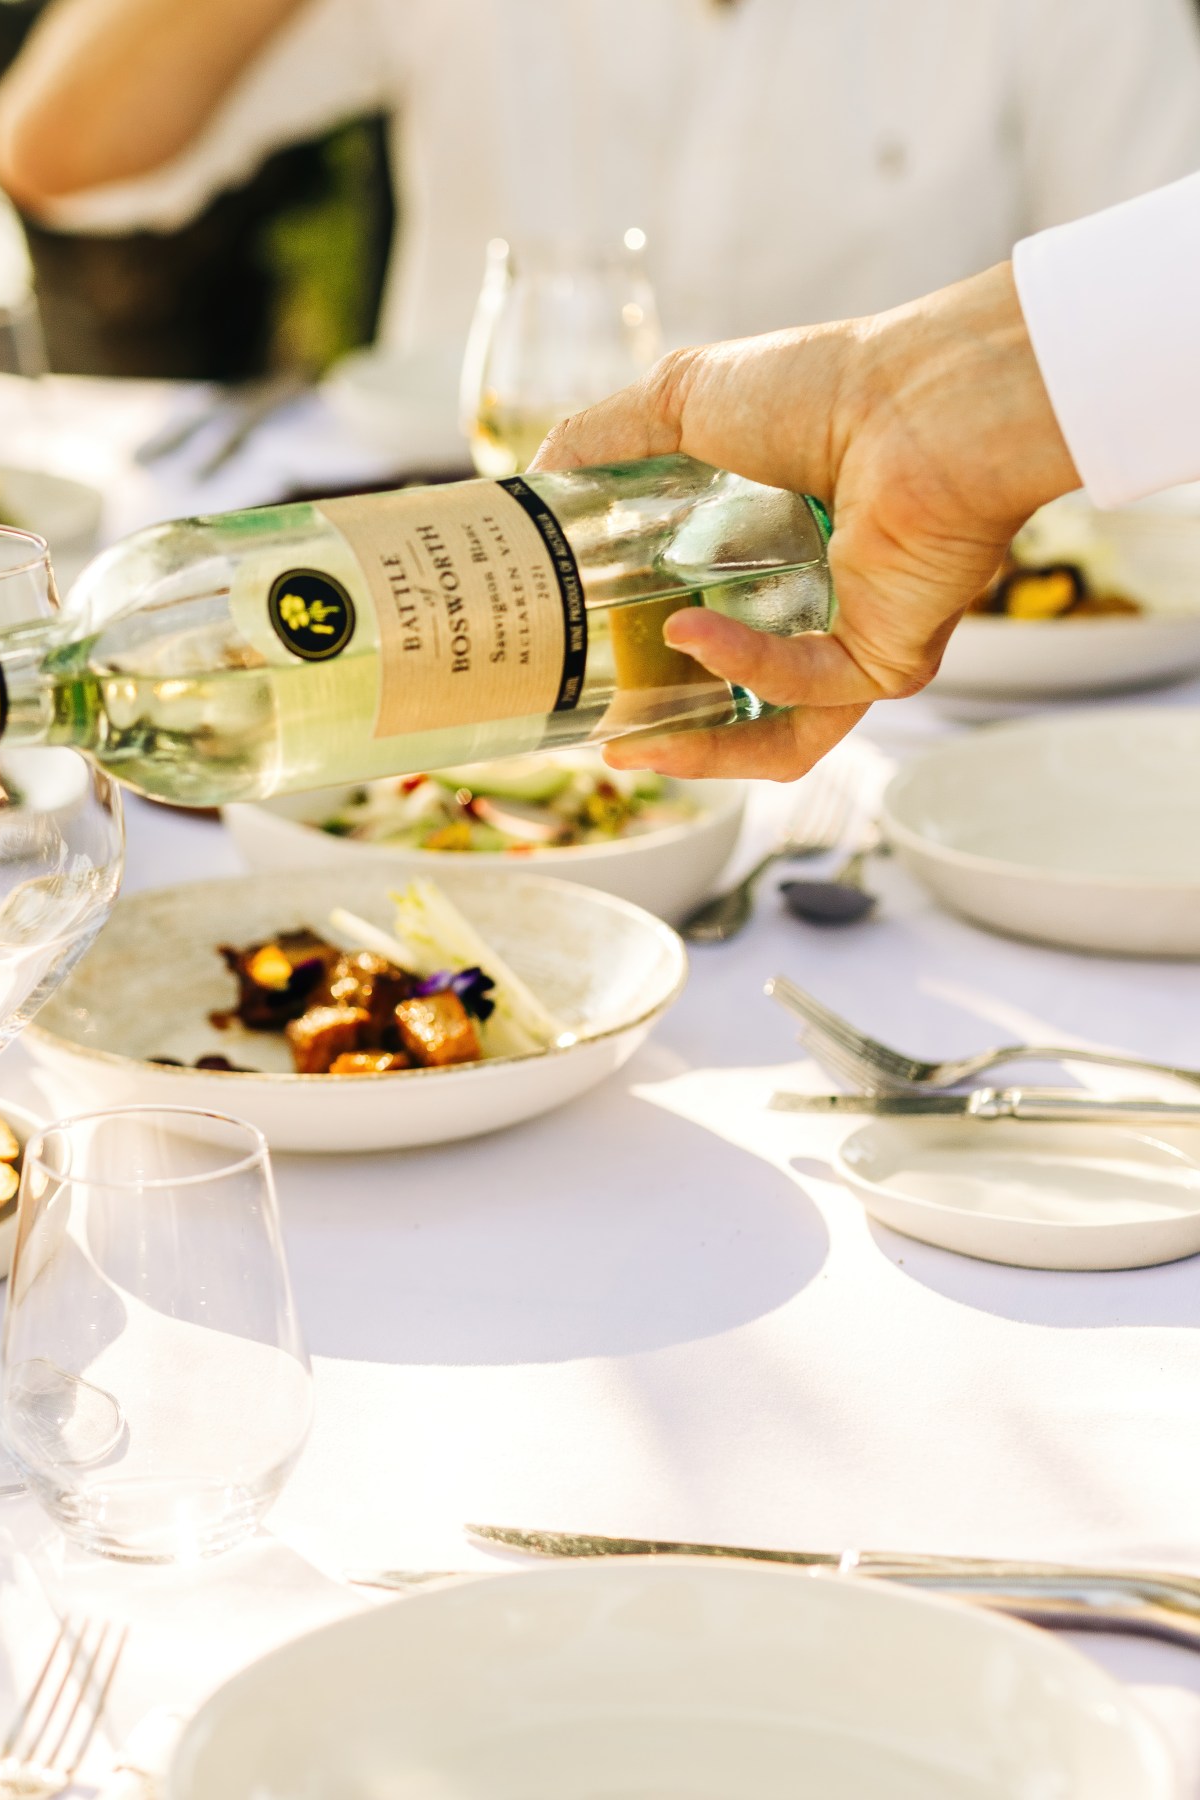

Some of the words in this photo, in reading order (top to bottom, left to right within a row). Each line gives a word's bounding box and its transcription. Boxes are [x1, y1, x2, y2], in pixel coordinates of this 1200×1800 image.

[461, 523, 488, 563] Blanc
[380, 554, 422, 651] BATTLE
[413, 584, 438, 608] of
[416, 525, 472, 673] BOSWORTH
[531, 564, 551, 600] 2021
[563, 576, 583, 622] PRODUCT
[484, 571, 508, 664] Sauvignon
